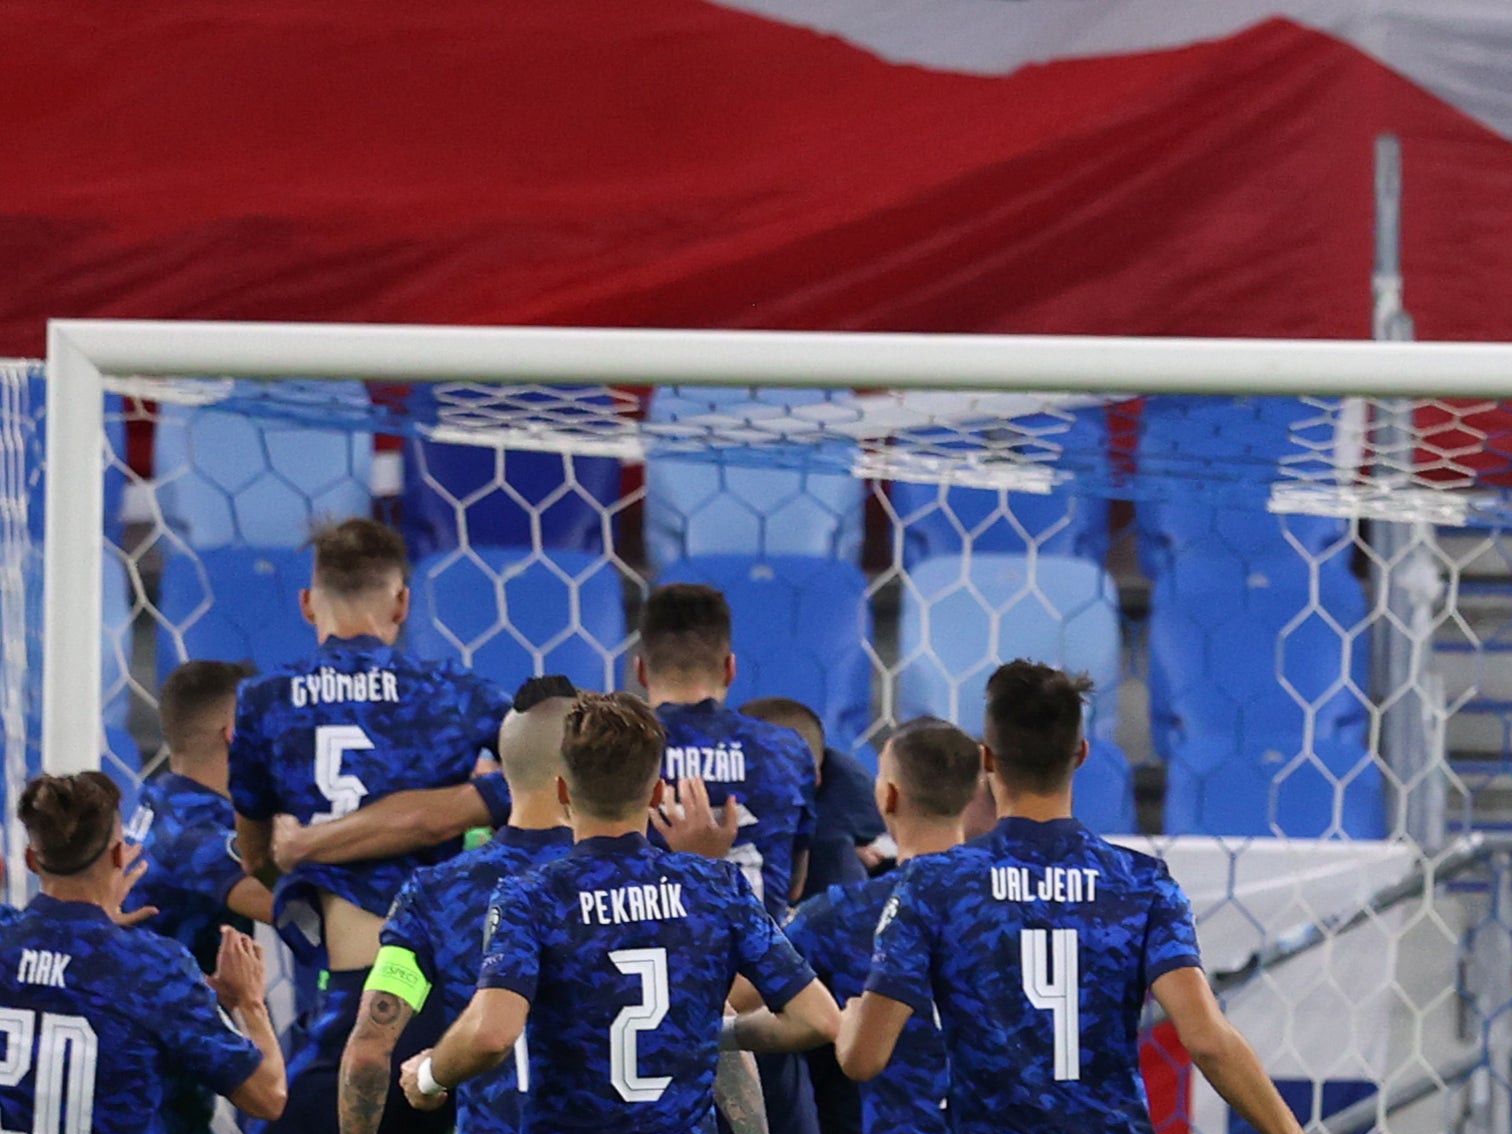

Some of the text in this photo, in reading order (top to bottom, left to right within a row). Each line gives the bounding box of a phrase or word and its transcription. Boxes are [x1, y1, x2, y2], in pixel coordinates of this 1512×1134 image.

[291, 666, 399, 708] GYÖMBÉR
[314, 724, 376, 824] 5
[665, 741, 746, 782] MAZÁŇ
[578, 876, 688, 925] PEKARÍK
[17, 948, 72, 989] MAK
[607, 947, 673, 1102] 2
[1020, 928, 1081, 1081] 4
